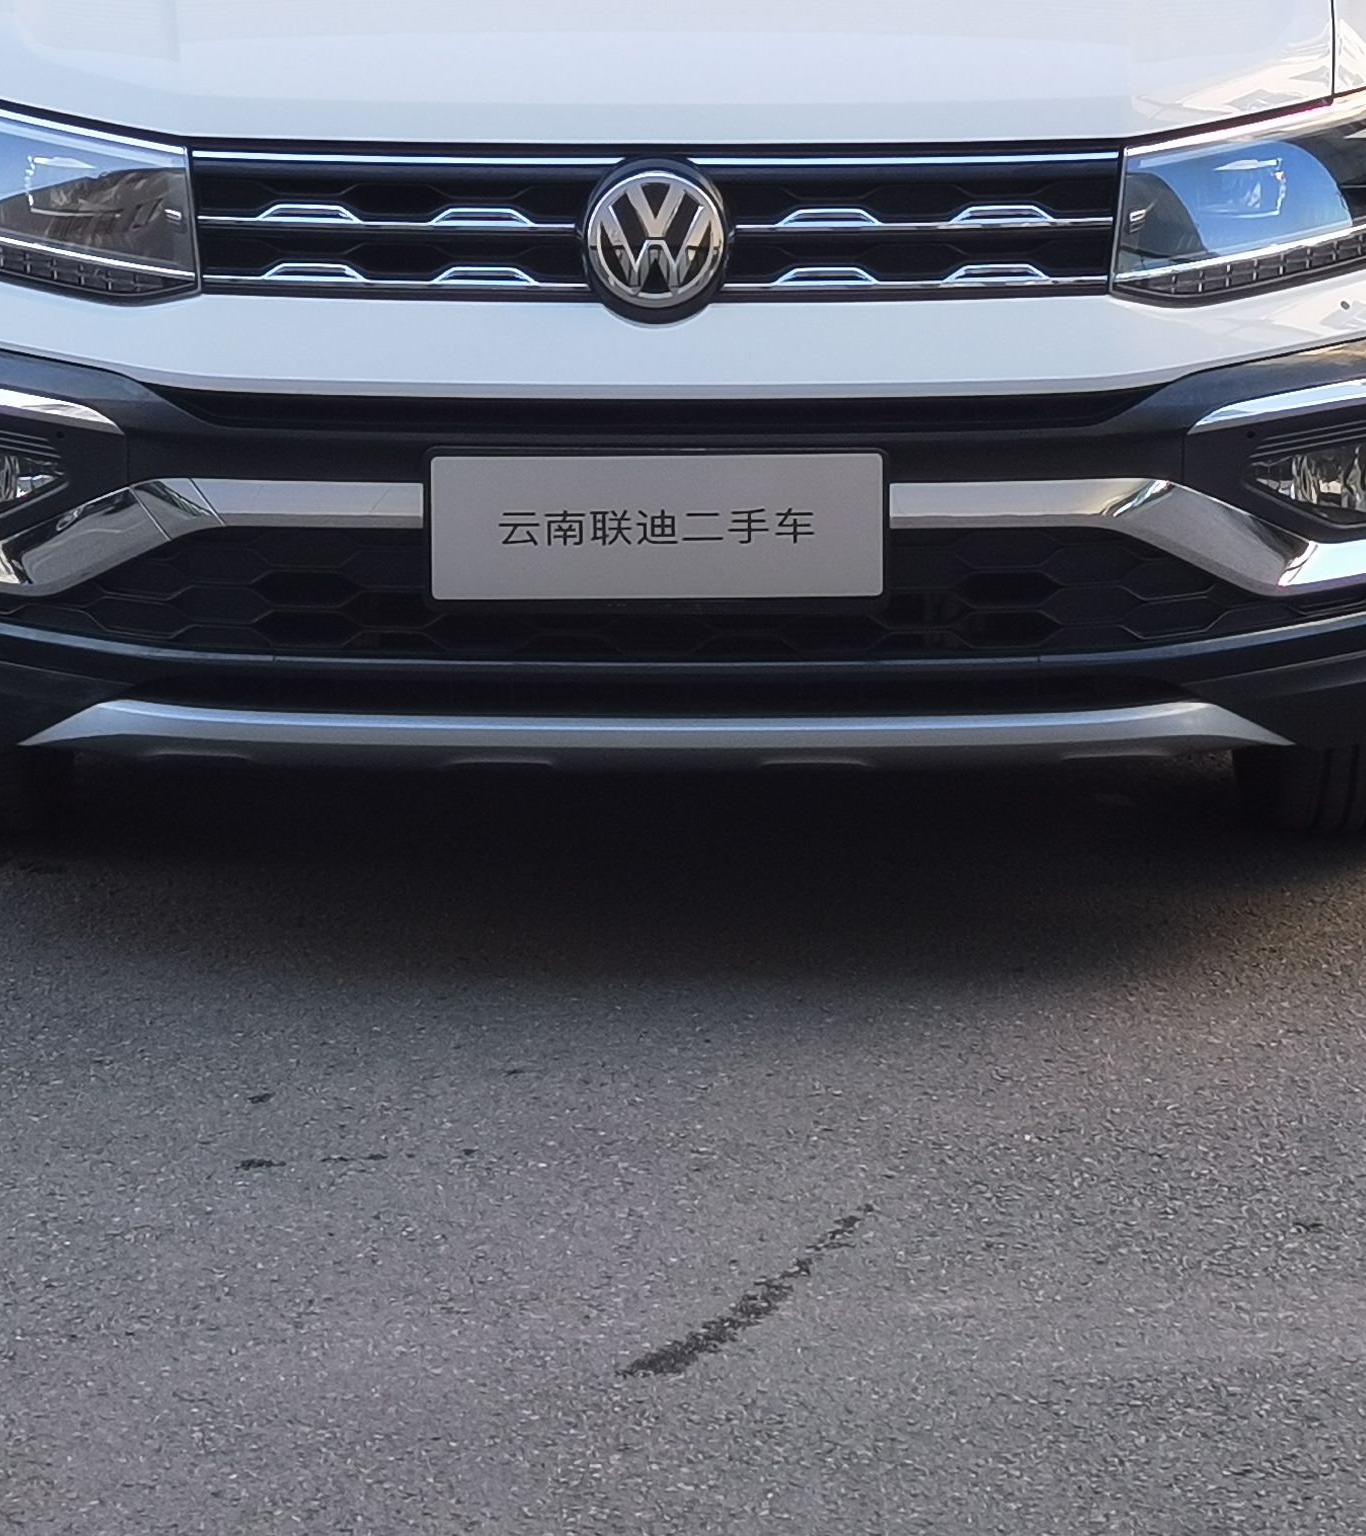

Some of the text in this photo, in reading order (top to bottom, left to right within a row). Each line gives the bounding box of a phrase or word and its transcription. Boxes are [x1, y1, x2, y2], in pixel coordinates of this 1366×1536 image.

[498, 507, 816, 547] 云南联迪二手车
